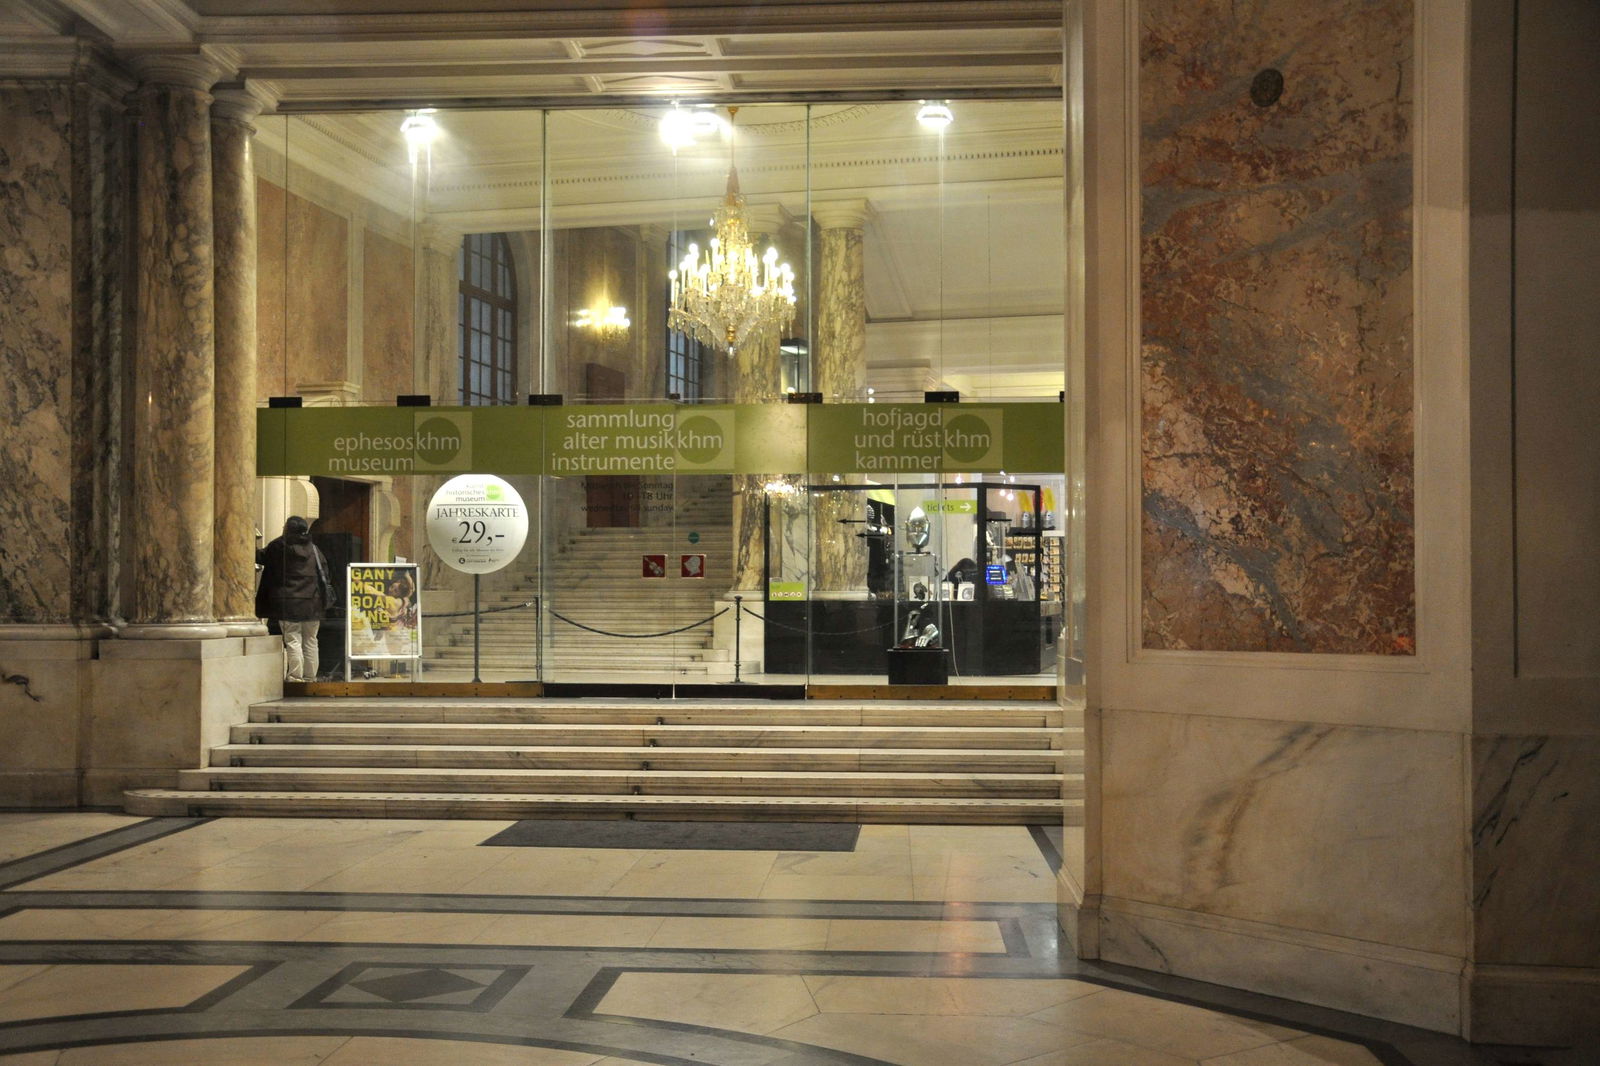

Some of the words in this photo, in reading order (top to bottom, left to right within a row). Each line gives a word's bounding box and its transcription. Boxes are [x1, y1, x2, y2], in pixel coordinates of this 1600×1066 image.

[567, 409, 674, 431] sammlung
[862, 407, 942, 430] hofjagd
[334, 432, 415, 456] ephesos
[416, 432, 460, 451] khm
[563, 431, 608, 449] alter
[615, 430, 674, 449] musik
[677, 431, 722, 449] khm
[854, 430, 895, 448] und
[903, 430, 941, 448] rüst
[944, 430, 990, 448] khm
[329, 456, 414, 471] museum
[551, 453, 675, 471] instrumente
[855, 451, 942, 469] kammer
[656, 492, 673, 500] Uhr
[436, 508, 520, 520] JAHRESKARTE
[351, 568, 395, 580] GANY
[351, 582, 385, 594] MED
[351, 596, 396, 609] BOAR
